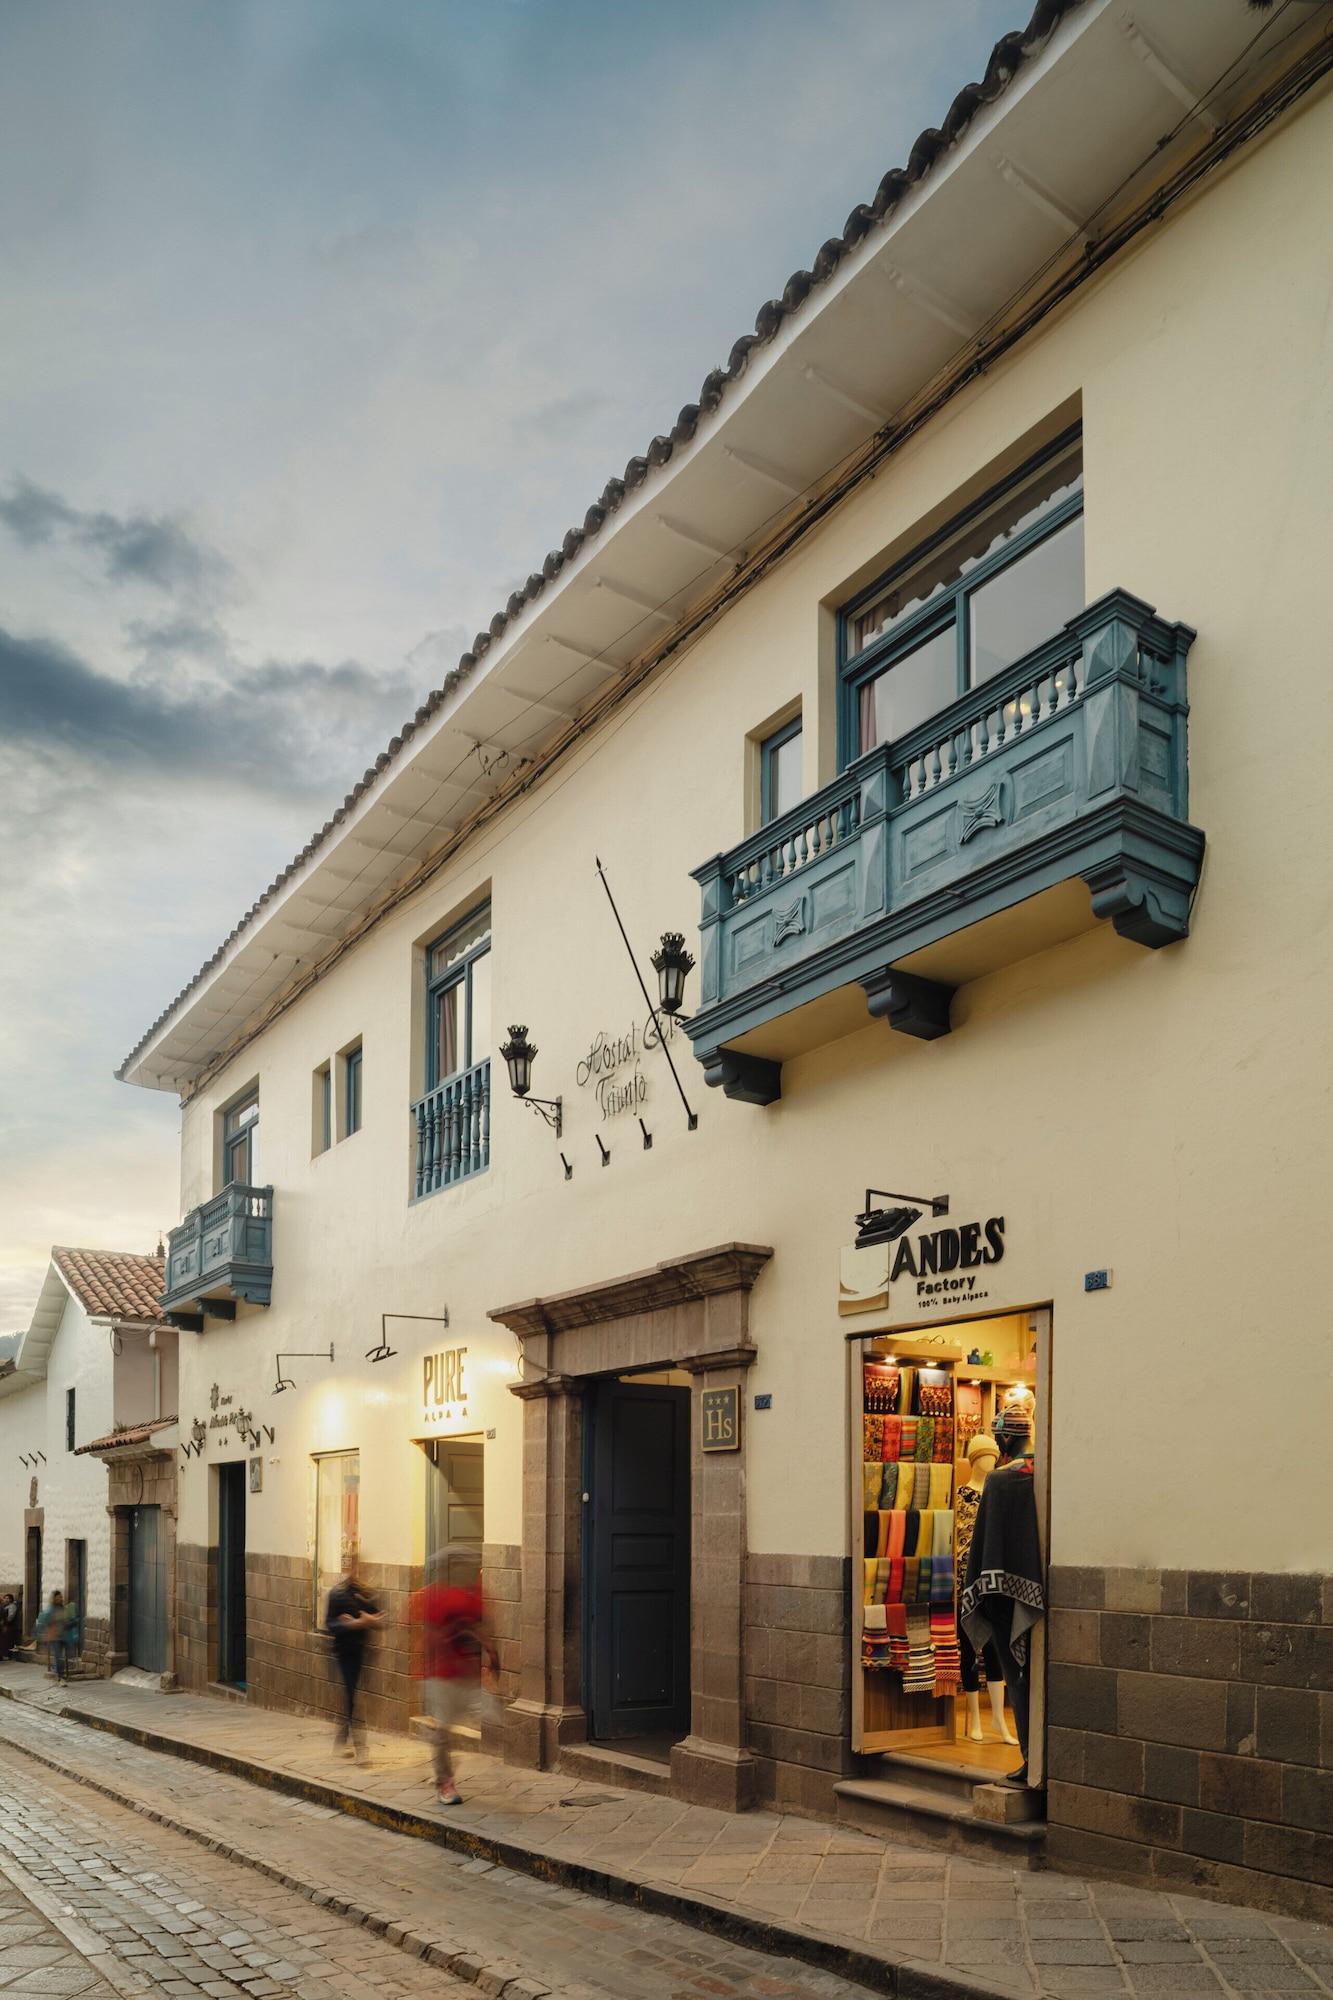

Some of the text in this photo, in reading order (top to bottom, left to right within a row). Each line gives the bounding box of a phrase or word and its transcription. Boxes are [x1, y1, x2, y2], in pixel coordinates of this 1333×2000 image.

[577, 1020, 640, 1087] Hostal
[596, 1057, 648, 1121] Triunfo
[890, 1216, 1005, 1282] ANDES
[916, 1275, 976, 1296] Factory
[918, 1291, 989, 1309] 100% Baby Alpaca
[424, 1347, 467, 1407] PURE
[424, 1407, 468, 1423] ALPAA
[706, 1409, 732, 1440] Hs
